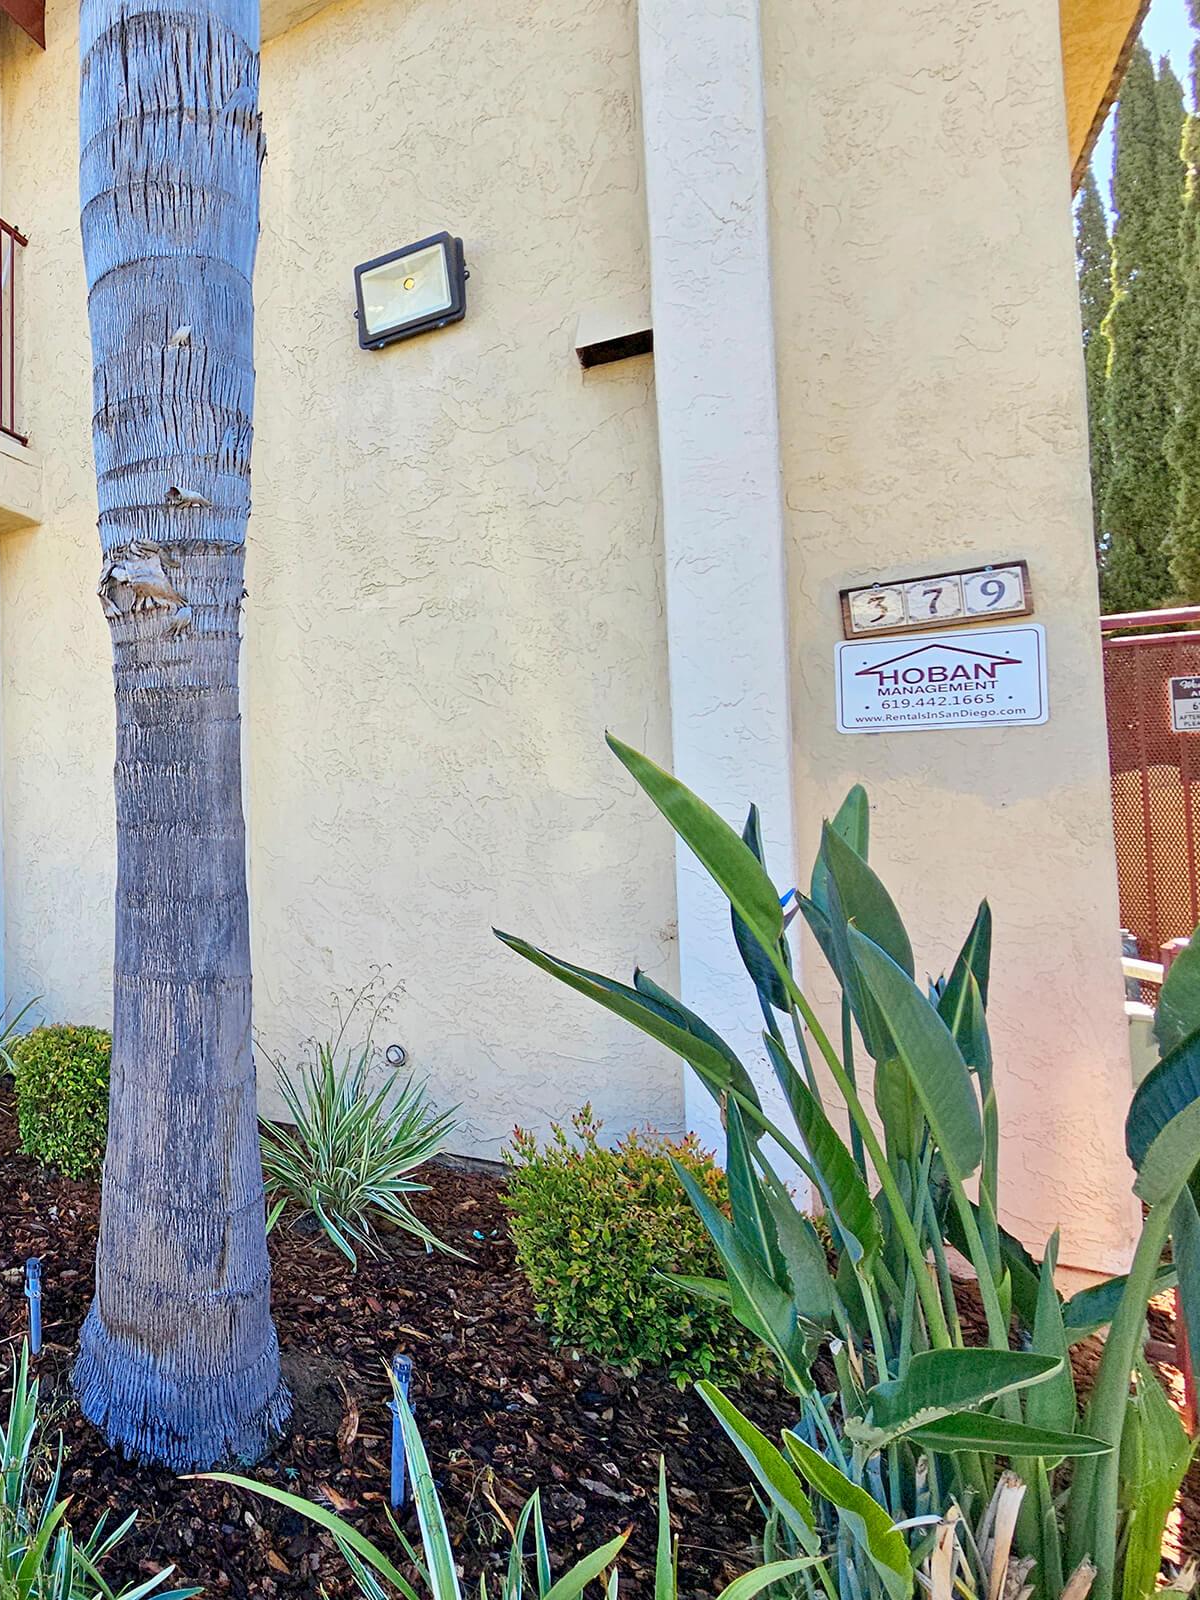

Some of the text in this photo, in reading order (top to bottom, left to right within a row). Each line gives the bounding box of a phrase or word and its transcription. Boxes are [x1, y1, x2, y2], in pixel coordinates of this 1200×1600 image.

[868, 579, 1006, 623] 379
[879, 663, 996, 686] HOBAN
[878, 680, 999, 696] MANAGEMENT
[881, 694, 995, 709] 619.442.1665
[855, 708, 1027, 722] www.RentalsInSanDiego.com
